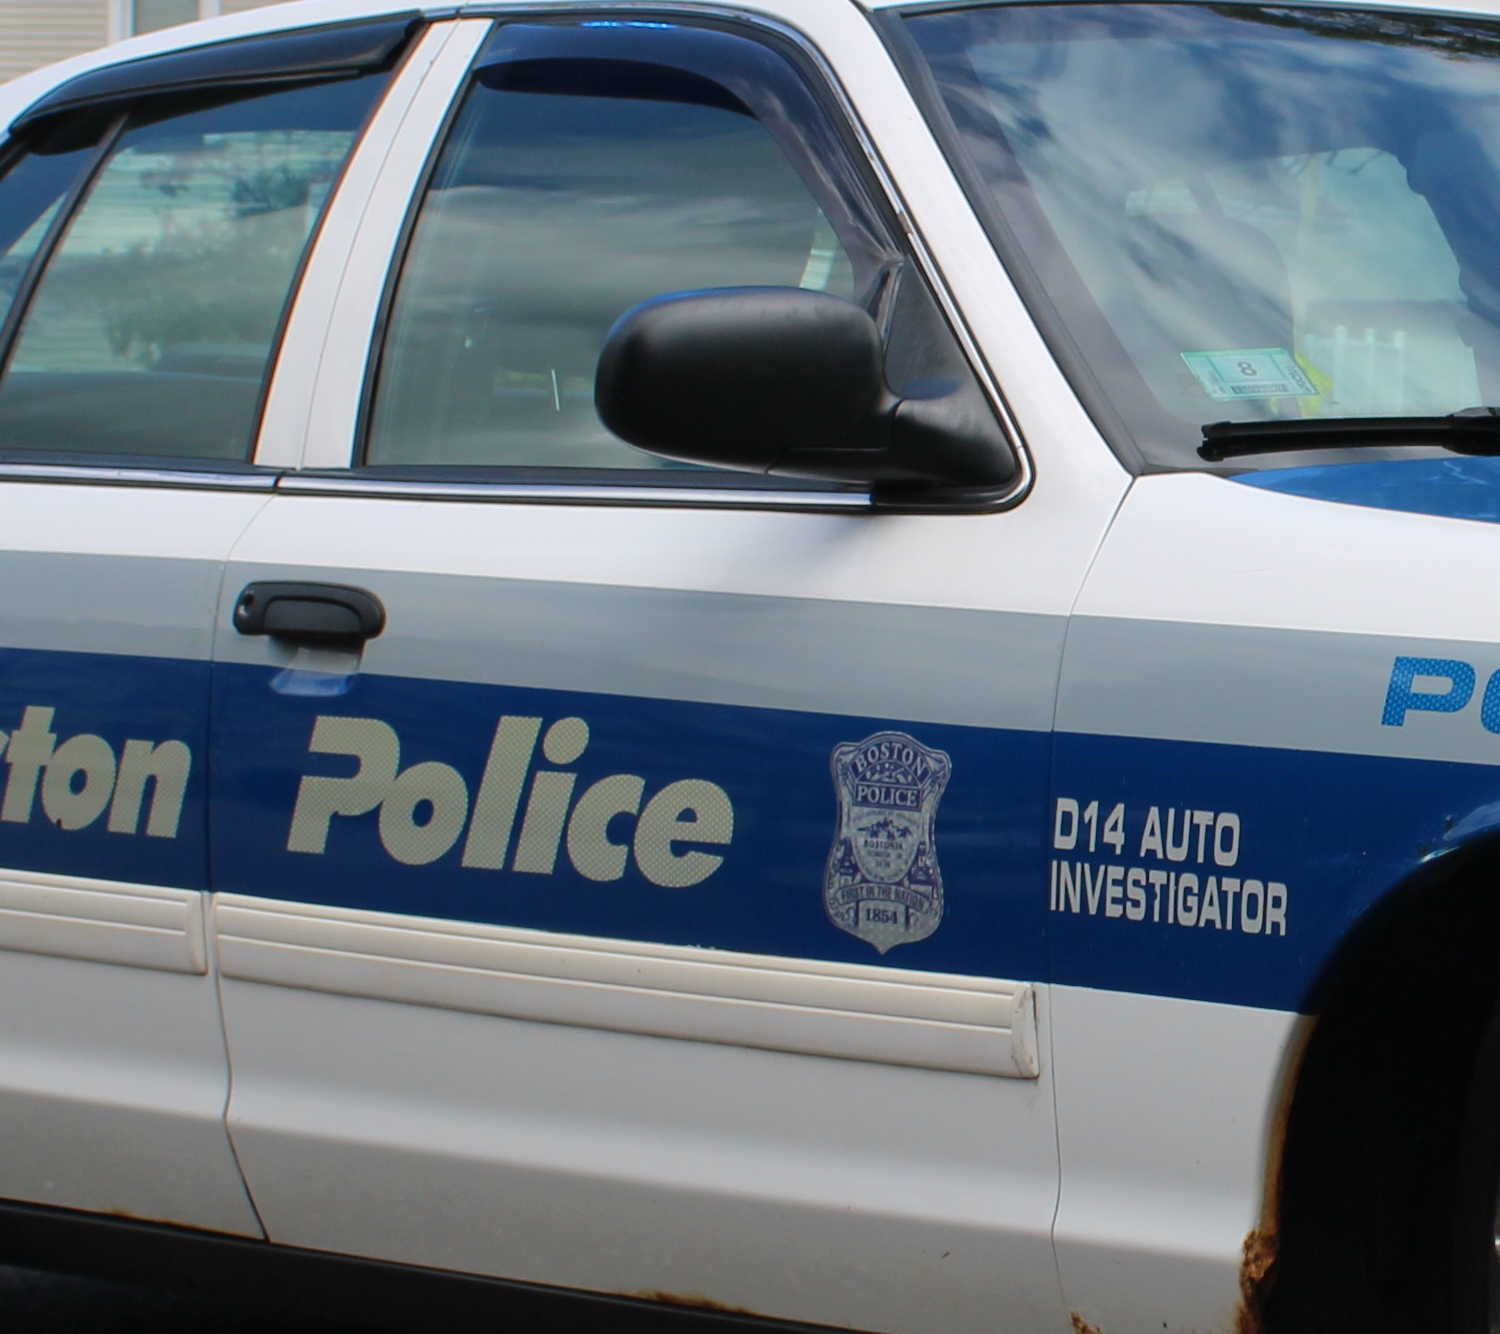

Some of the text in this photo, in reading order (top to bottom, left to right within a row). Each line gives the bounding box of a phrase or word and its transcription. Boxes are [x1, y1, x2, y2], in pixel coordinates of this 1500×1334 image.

[855, 741, 926, 777] BOSTON
[287, 715, 735, 888] Police
[856, 785, 918, 807] POLICE
[1053, 797, 1241, 867] D14 AUTO
[866, 907, 898, 924] 1854
[1050, 859, 1288, 937] INVESTIGATOR
